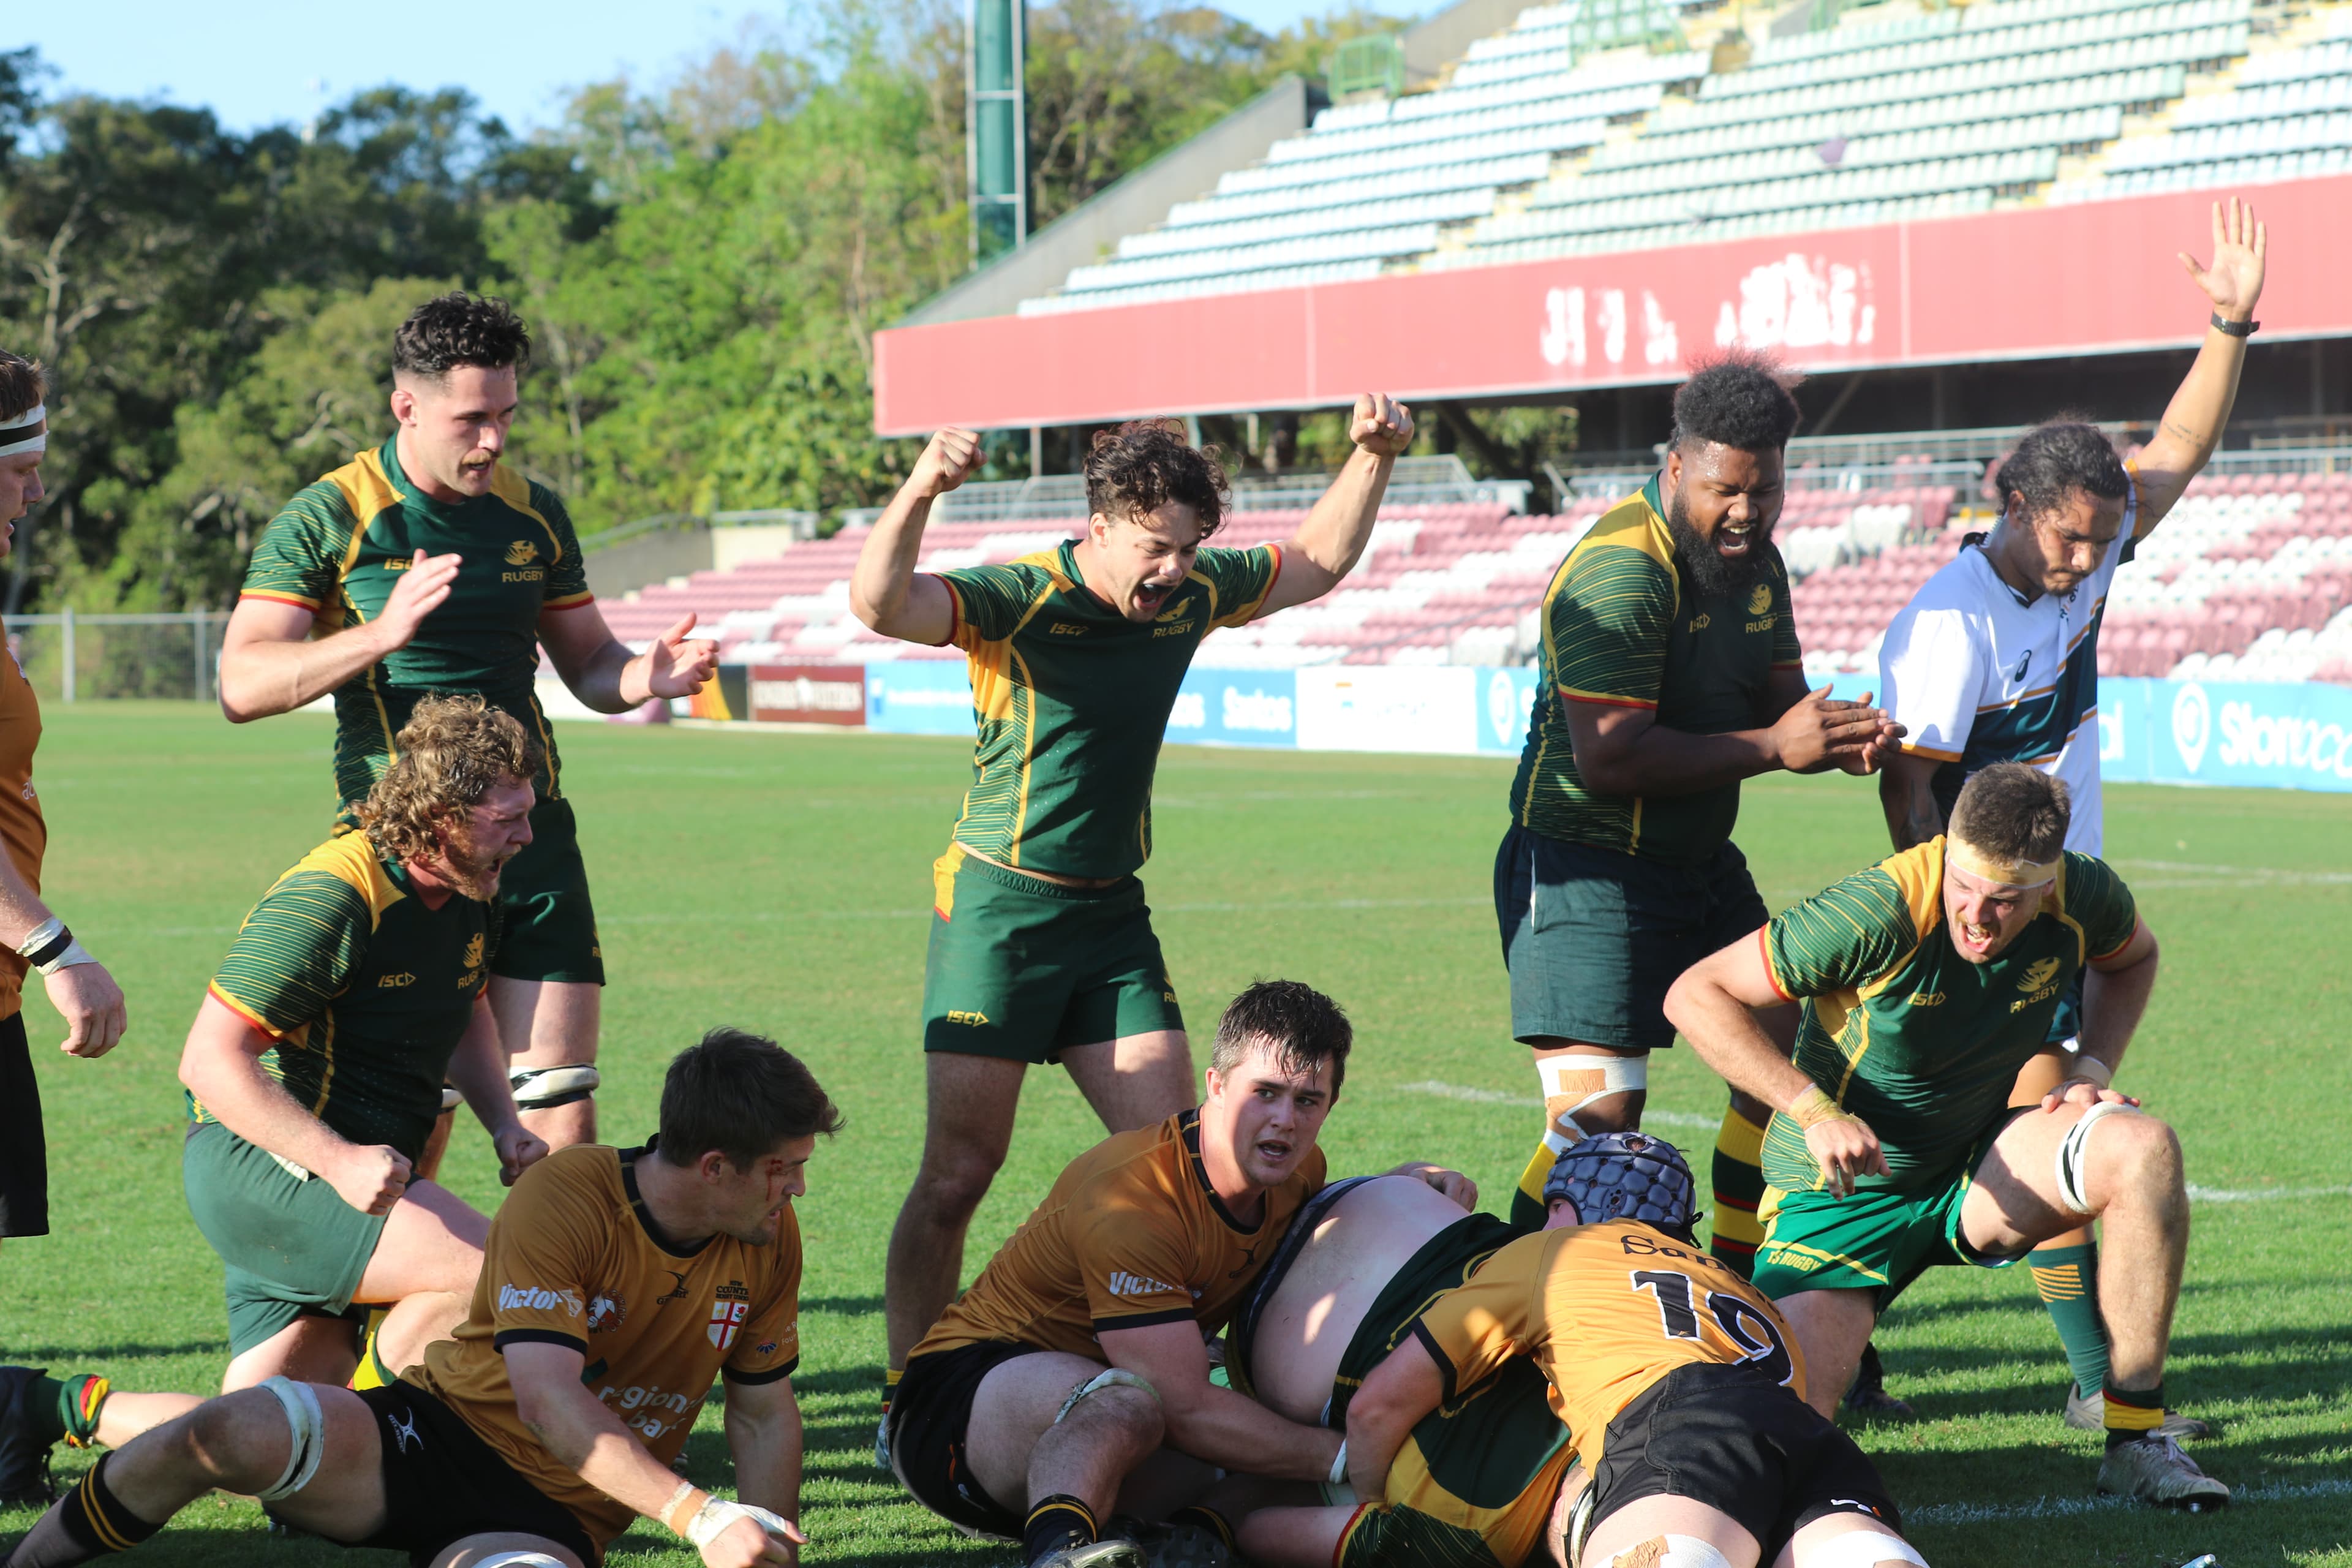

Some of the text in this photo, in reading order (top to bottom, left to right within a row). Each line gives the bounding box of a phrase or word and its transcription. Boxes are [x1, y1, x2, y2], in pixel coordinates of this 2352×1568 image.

[502, 570, 541, 583] RUGBY
[1152, 622, 1193, 638] RUGBY
[1745, 617, 1777, 634] RUGBY
[378, 975, 405, 988] ISC
[456, 970, 479, 990] RUG
[1907, 991, 1934, 1006] ISC
[2010, 984, 2057, 1014] RUGBY
[946, 1009, 976, 1025] ISC
[1778, 1251, 1822, 1272] RUGBY
